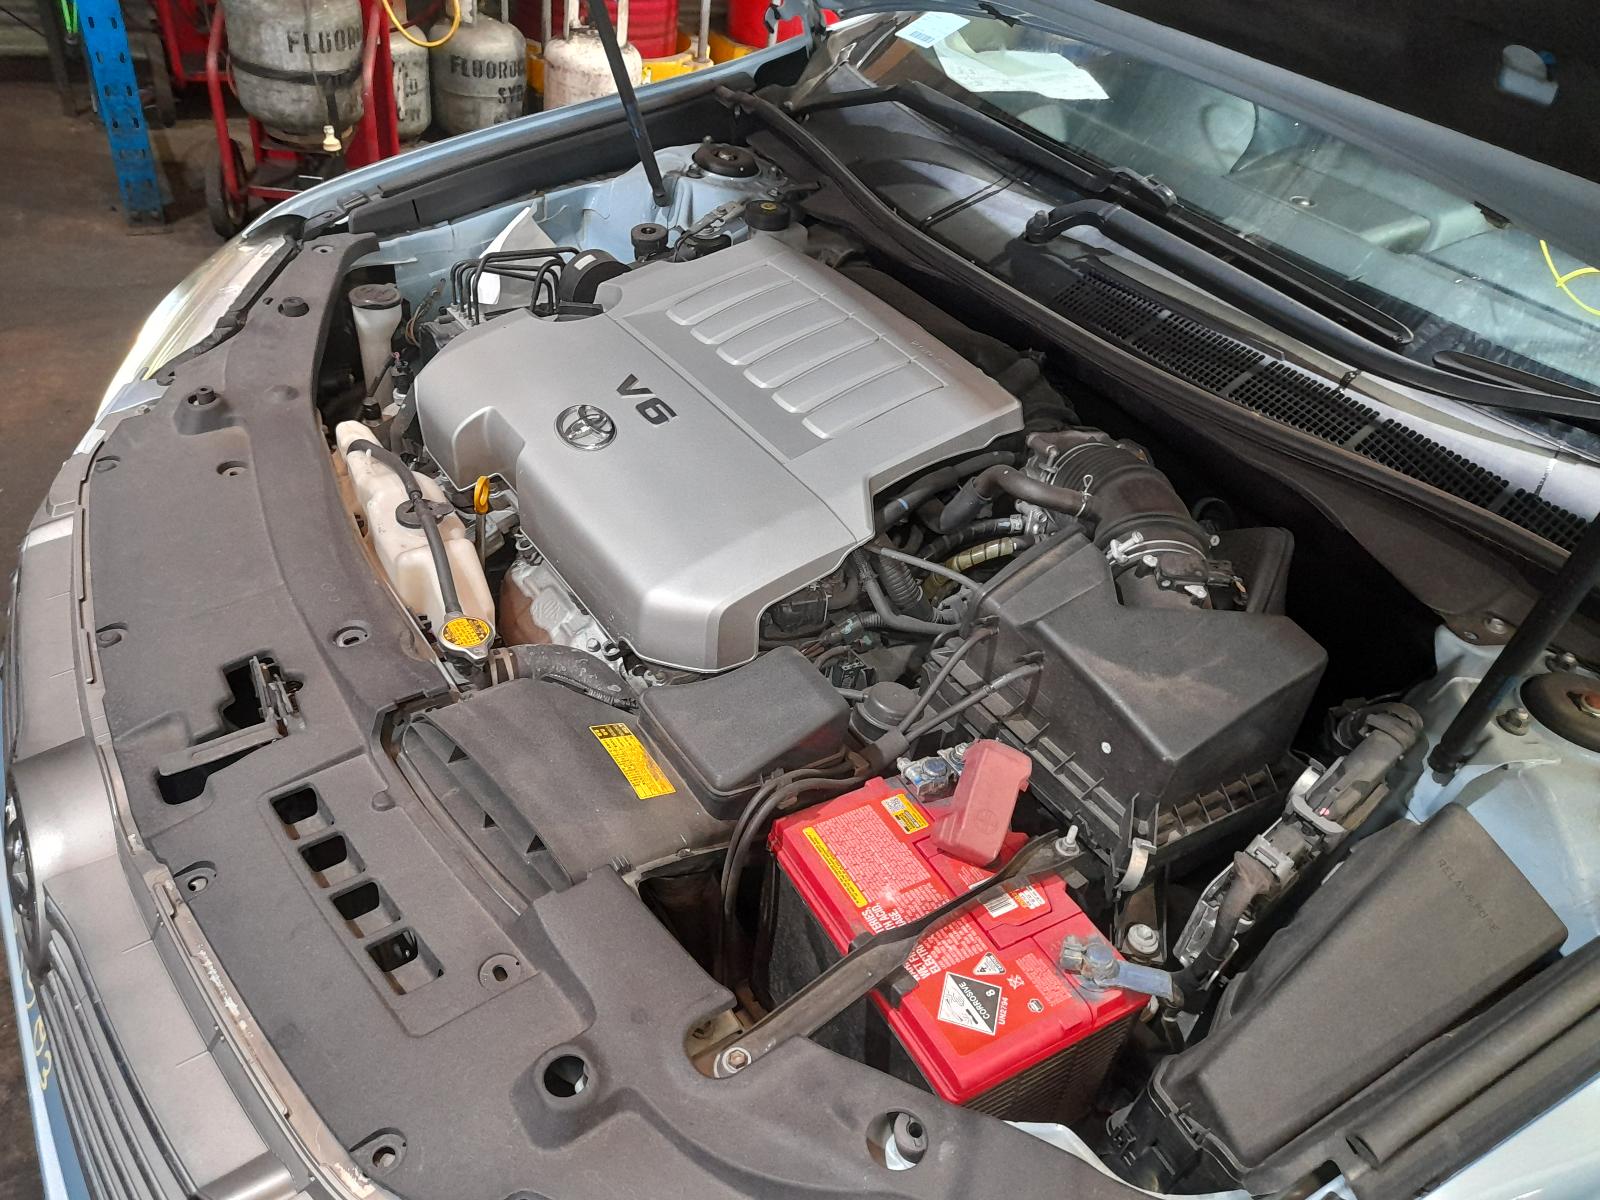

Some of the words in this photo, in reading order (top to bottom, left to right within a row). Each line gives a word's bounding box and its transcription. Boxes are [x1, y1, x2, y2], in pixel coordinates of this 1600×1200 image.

[616, 373, 678, 425] V6
[861, 906, 885, 934] TERIES,
[889, 908, 907, 928] AGE.
[913, 961, 931, 979] WET
[958, 981, 990, 1020] CORROSIVE
[985, 989, 996, 997] 8
[998, 997, 1009, 1025] UN2794
